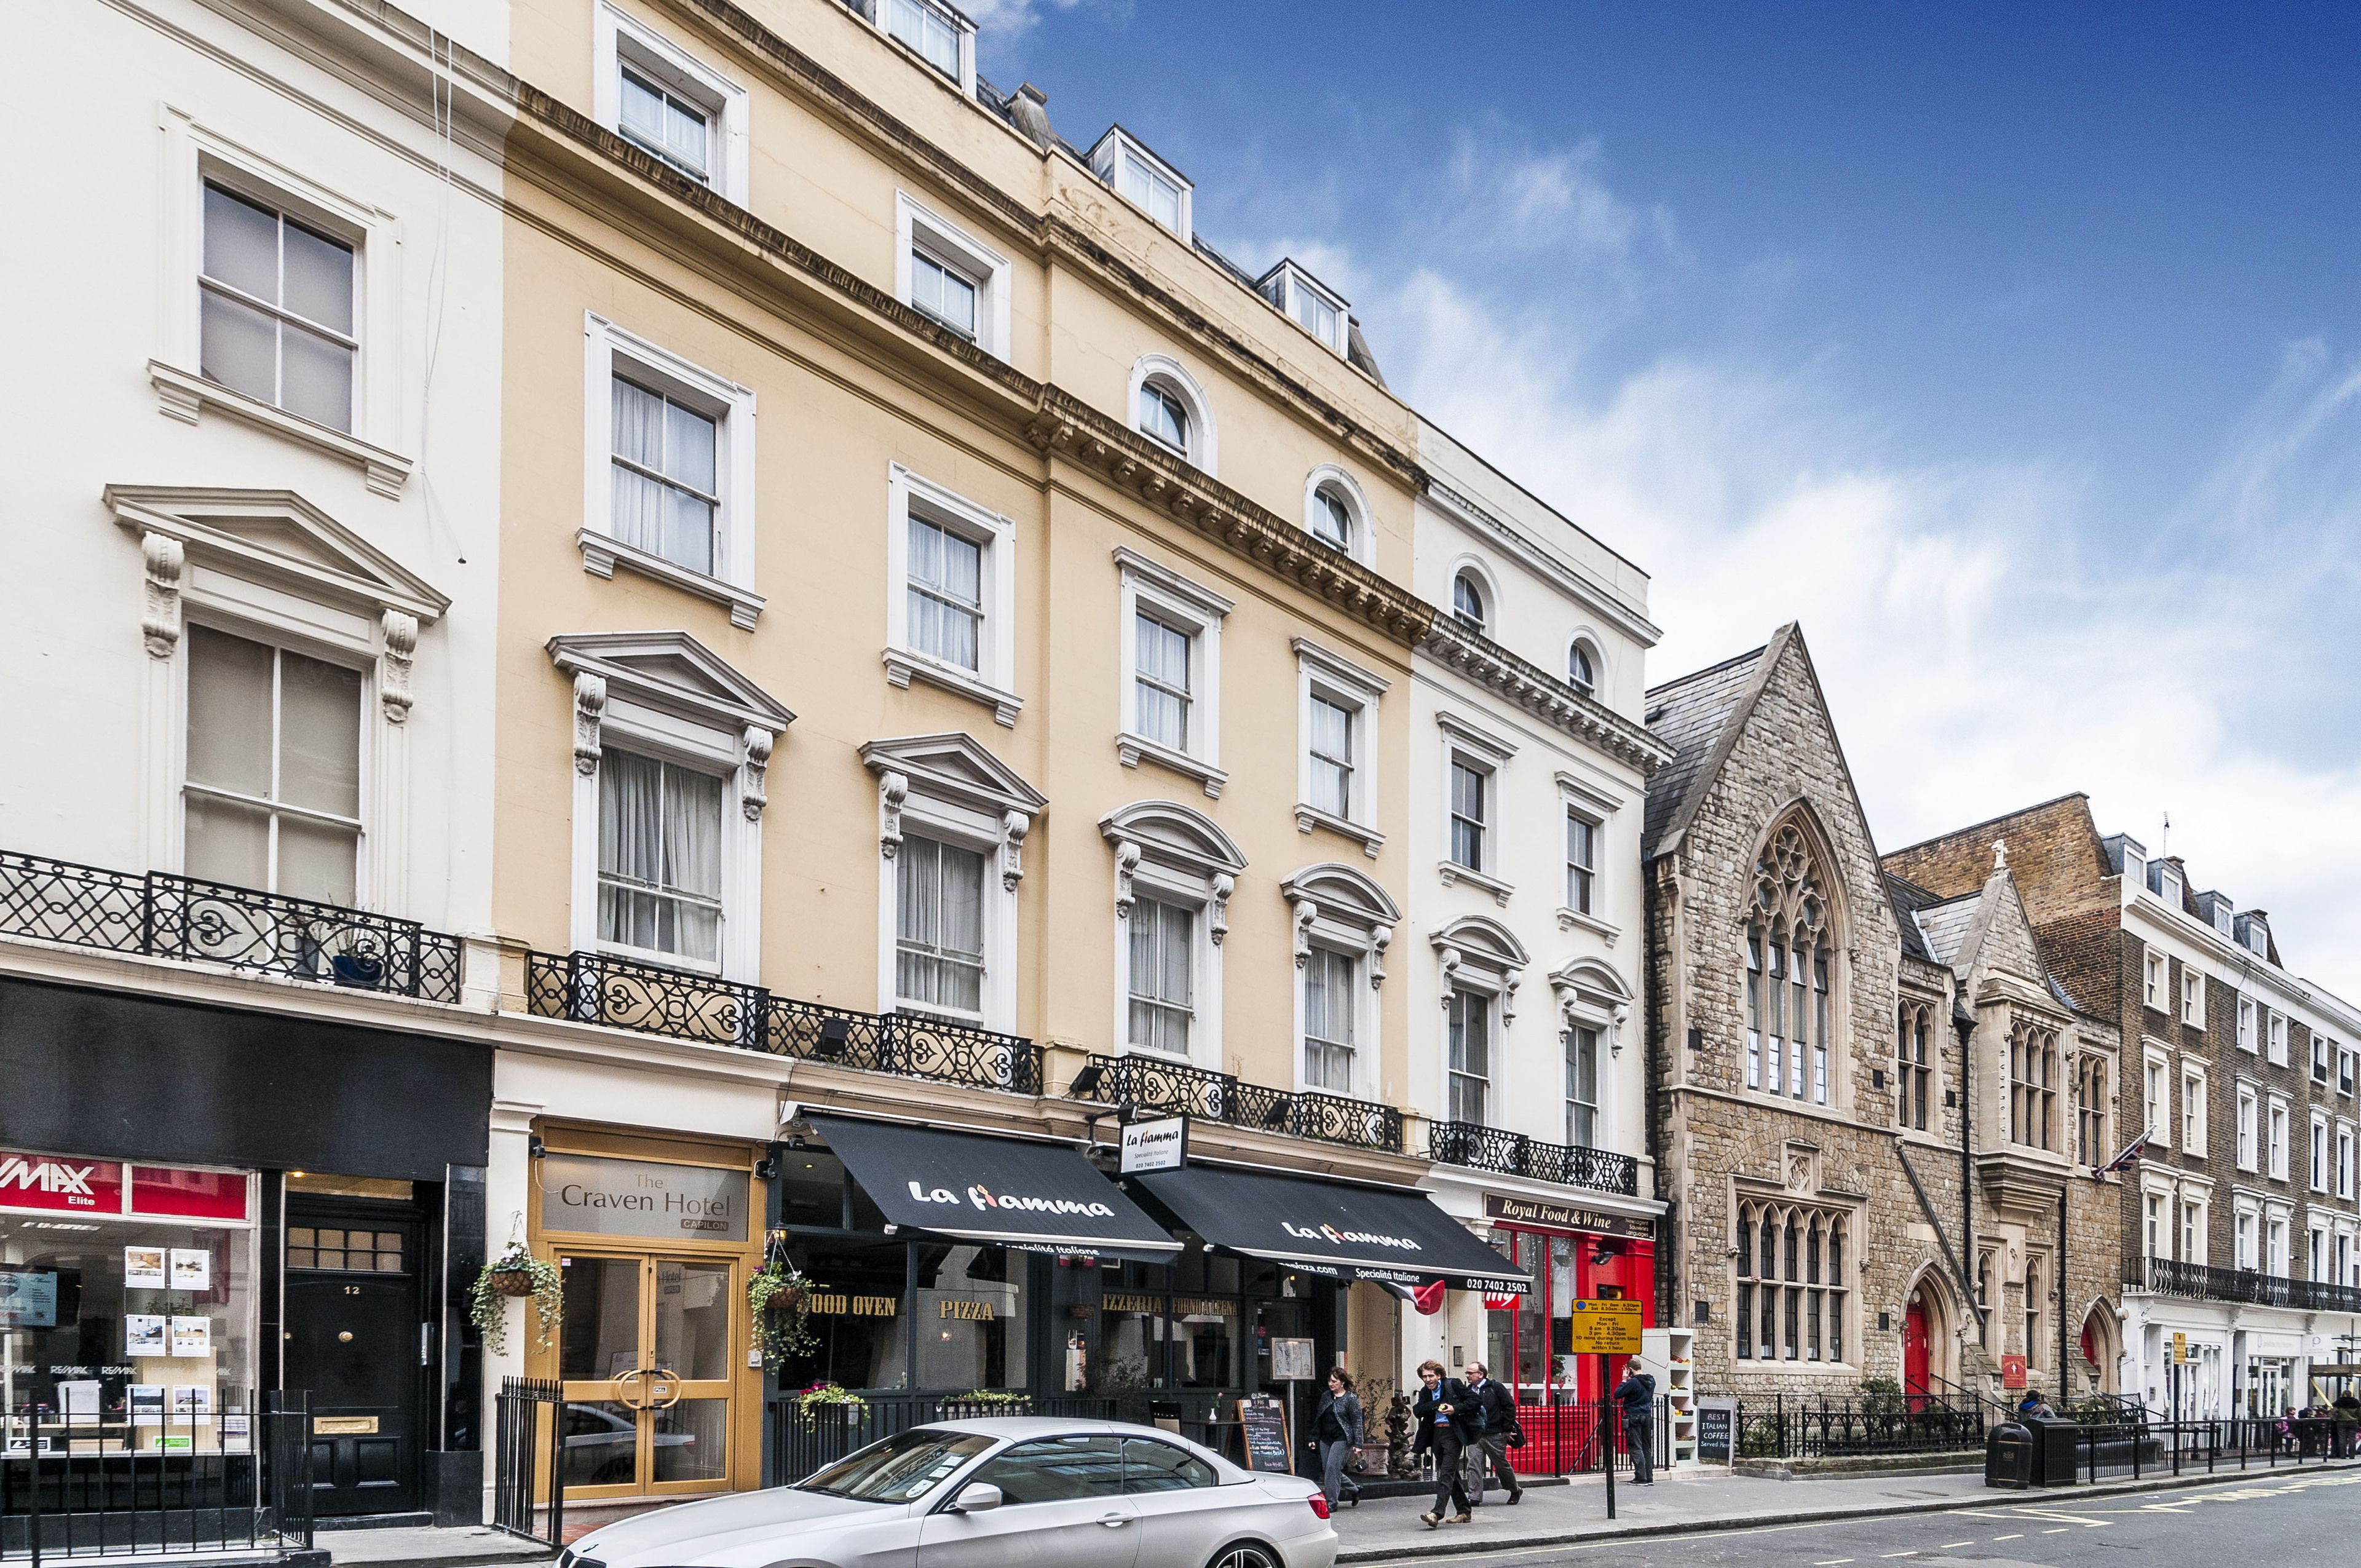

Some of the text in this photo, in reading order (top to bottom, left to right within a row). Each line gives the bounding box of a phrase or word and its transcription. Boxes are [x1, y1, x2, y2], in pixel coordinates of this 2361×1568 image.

[1126, 1130, 1179, 1147] La fiamma
[635, 1174, 663, 1189] The
[68, 1195, 95, 1206] Elite
[561, 1184, 730, 1216] Craven Hotel
[908, 1181, 1115, 1218] La fiamma
[1502, 1200, 1612, 1229] Royal Food & Wine
[683, 1220, 727, 1230] CAPILON
[1281, 1222, 1422, 1251] La fiamma
[1056, 1245, 1101, 1256] Italiane
[1393, 1272, 1420, 1283] Italiane
[1467, 1278, 1528, 1293] 020 7402 2502
[344, 1286, 360, 1294] 12
[798, 1293, 896, 1316] OOD OVEN
[939, 1300, 994, 1320] PIZZA
[1102, 1293, 1163, 1313] IZZERIA
[1173, 1296, 1240, 1317] FORNO A LEGNA
[50, 1365, 89, 1374] RE/MAX
[101, 1366, 138, 1375] RE/MAX
